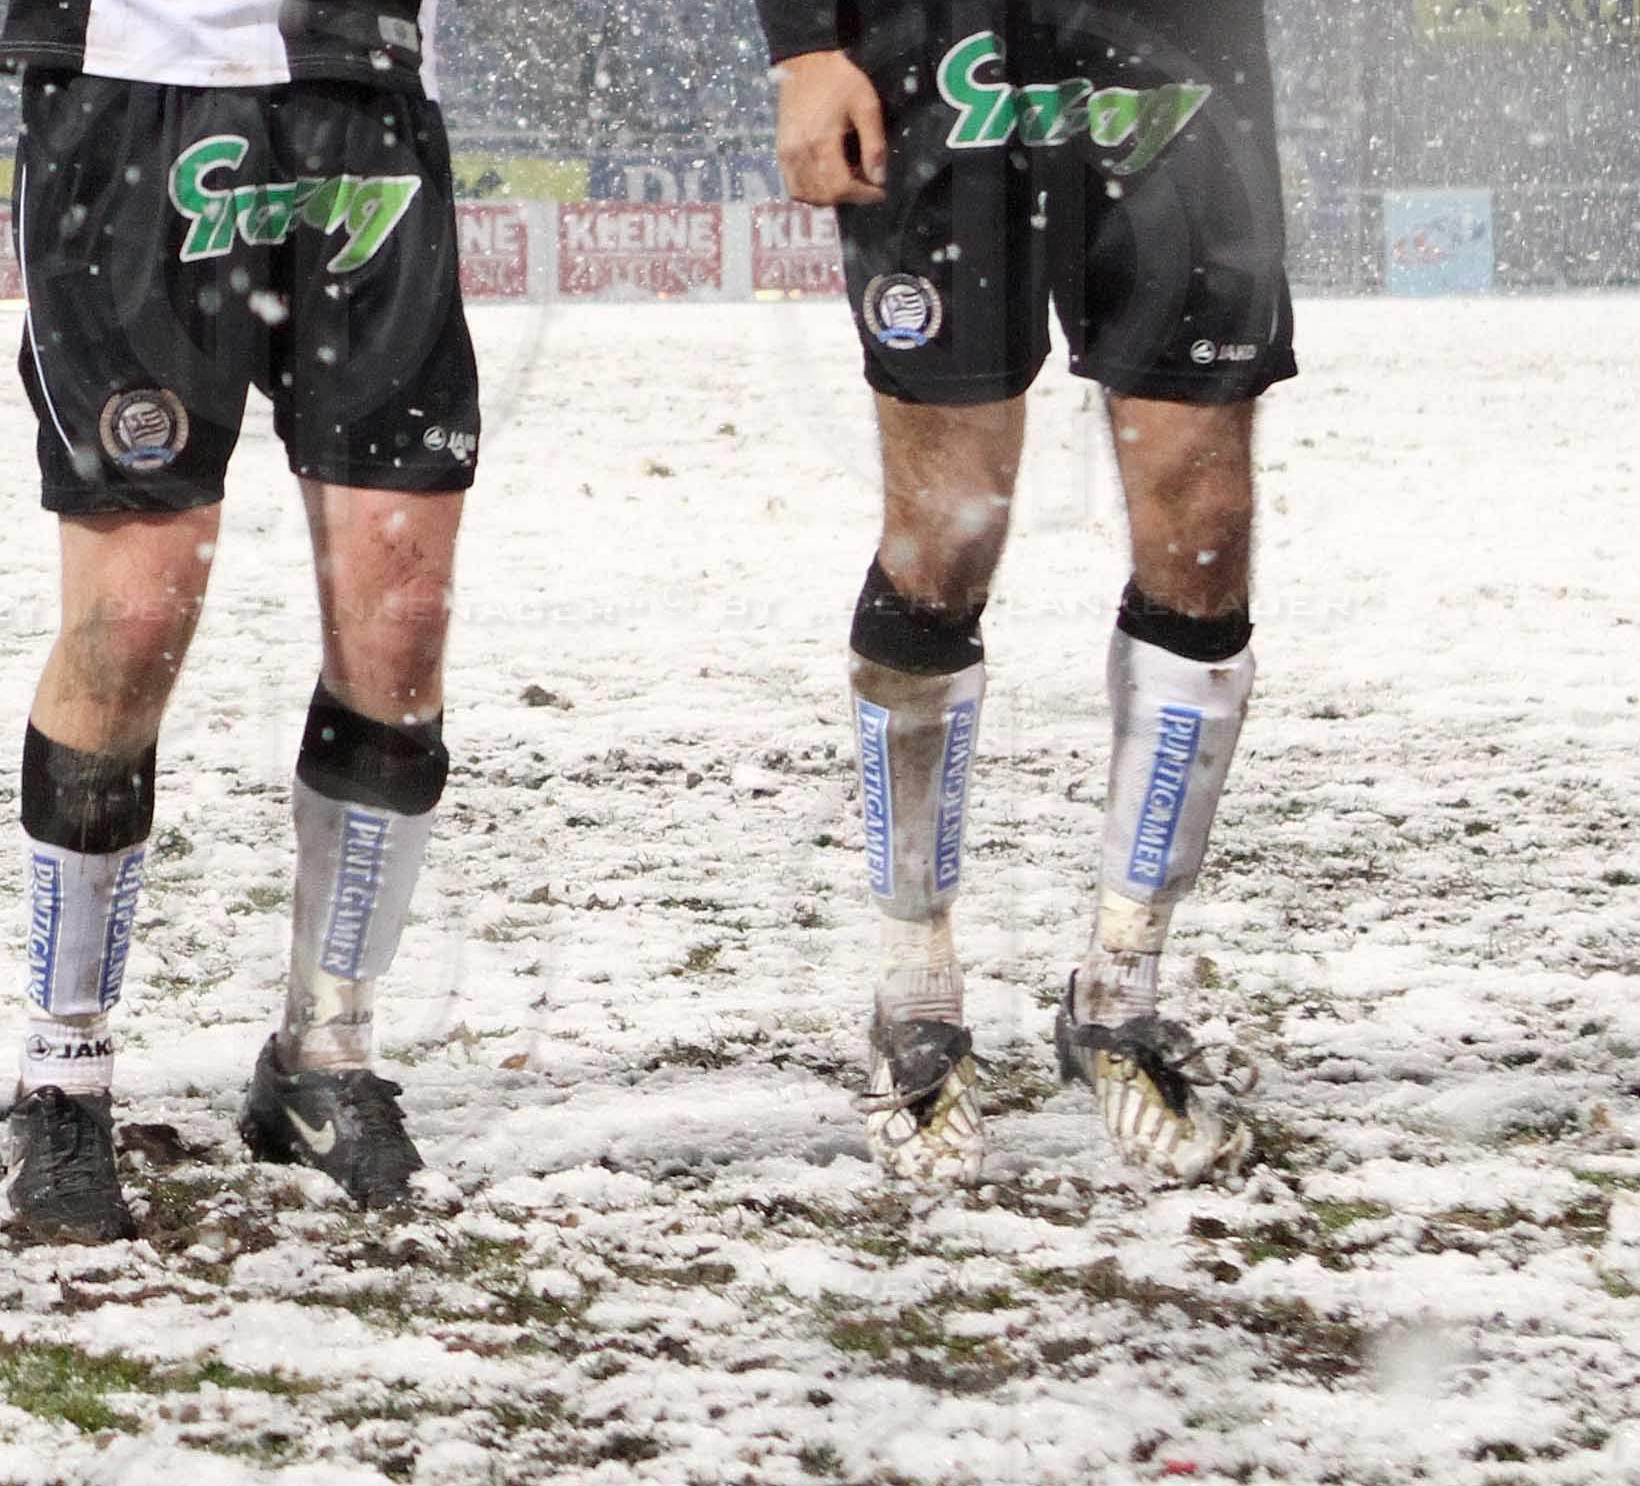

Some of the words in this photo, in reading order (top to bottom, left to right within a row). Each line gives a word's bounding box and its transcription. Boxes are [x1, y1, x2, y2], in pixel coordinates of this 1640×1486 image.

[861, 717, 889, 888] PUNTIGAMER
[939, 710, 974, 885] PUNTIGAMER
[1130, 715, 1195, 881] PUNTIGAMER
